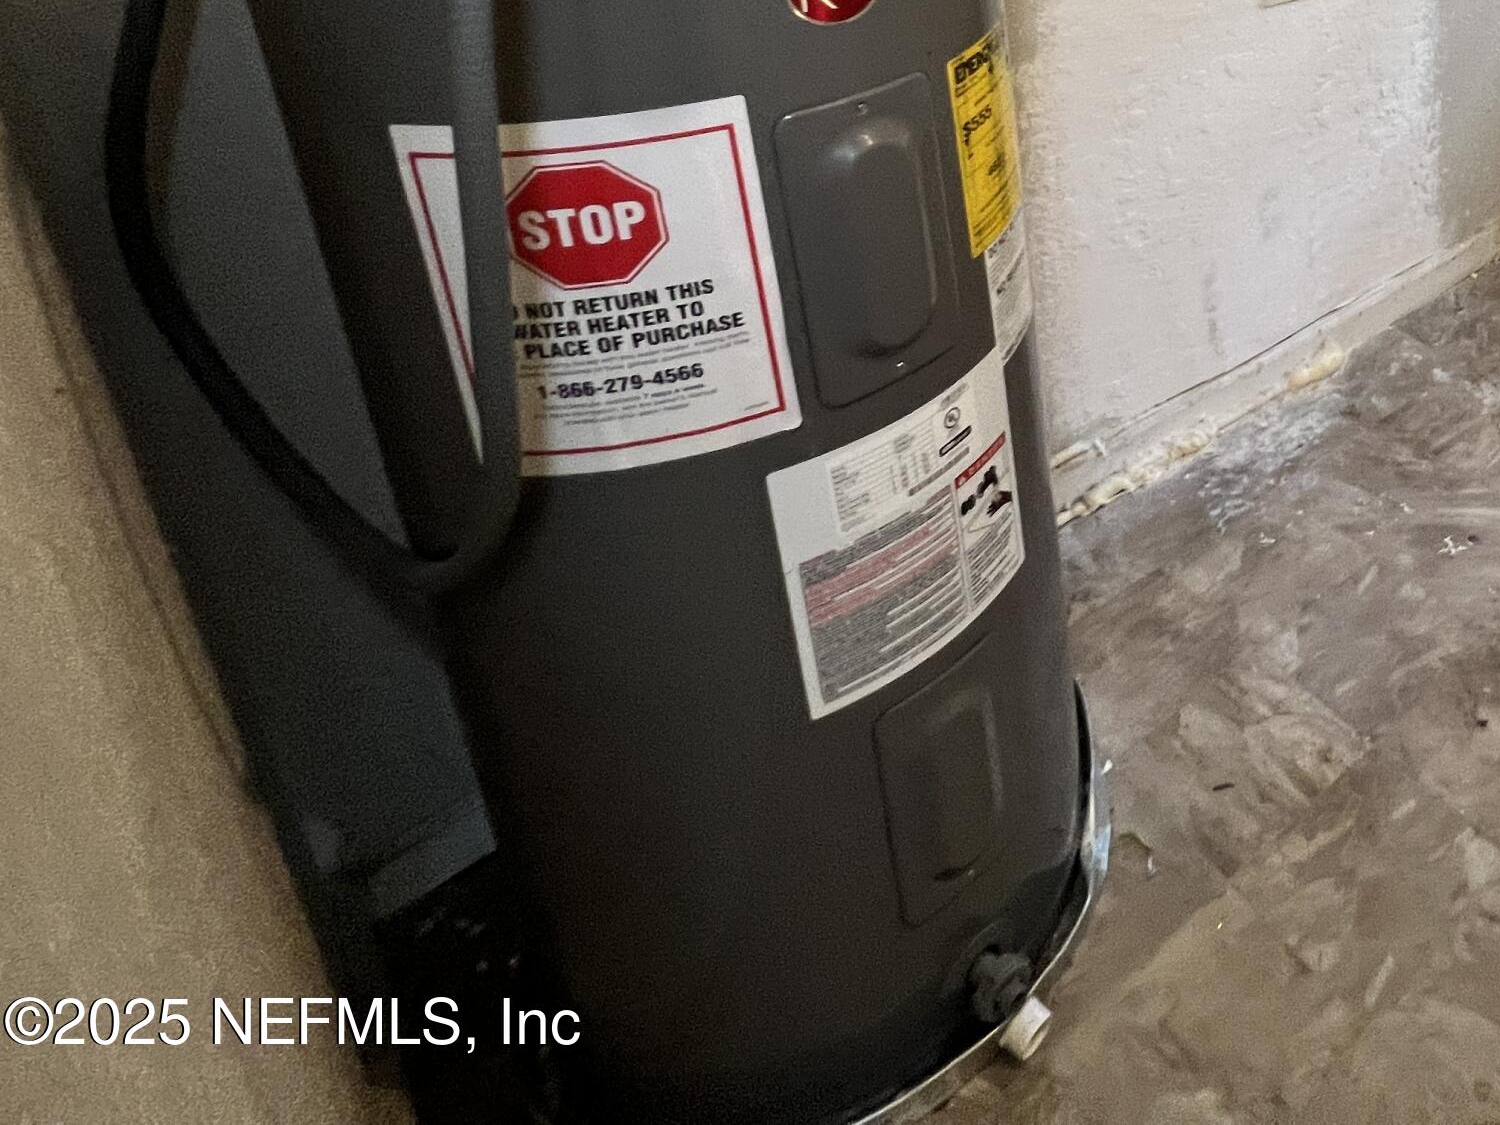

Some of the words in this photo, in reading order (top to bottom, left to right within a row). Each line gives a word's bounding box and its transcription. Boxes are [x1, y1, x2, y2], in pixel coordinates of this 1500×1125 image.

[517, 200, 646, 251] STOP
[525, 299, 565, 319] NOT
[574, 289, 659, 315] RETURN
[666, 278, 715, 302] THIS
[587, 306, 670, 335] HEATER
[679, 300, 705, 318] TO
[524, 339, 591, 360] PLACE
[597, 334, 624, 354] OF
[632, 311, 745, 349] PURCHASE
[537, 362, 705, 400] 1-866-279-4566
